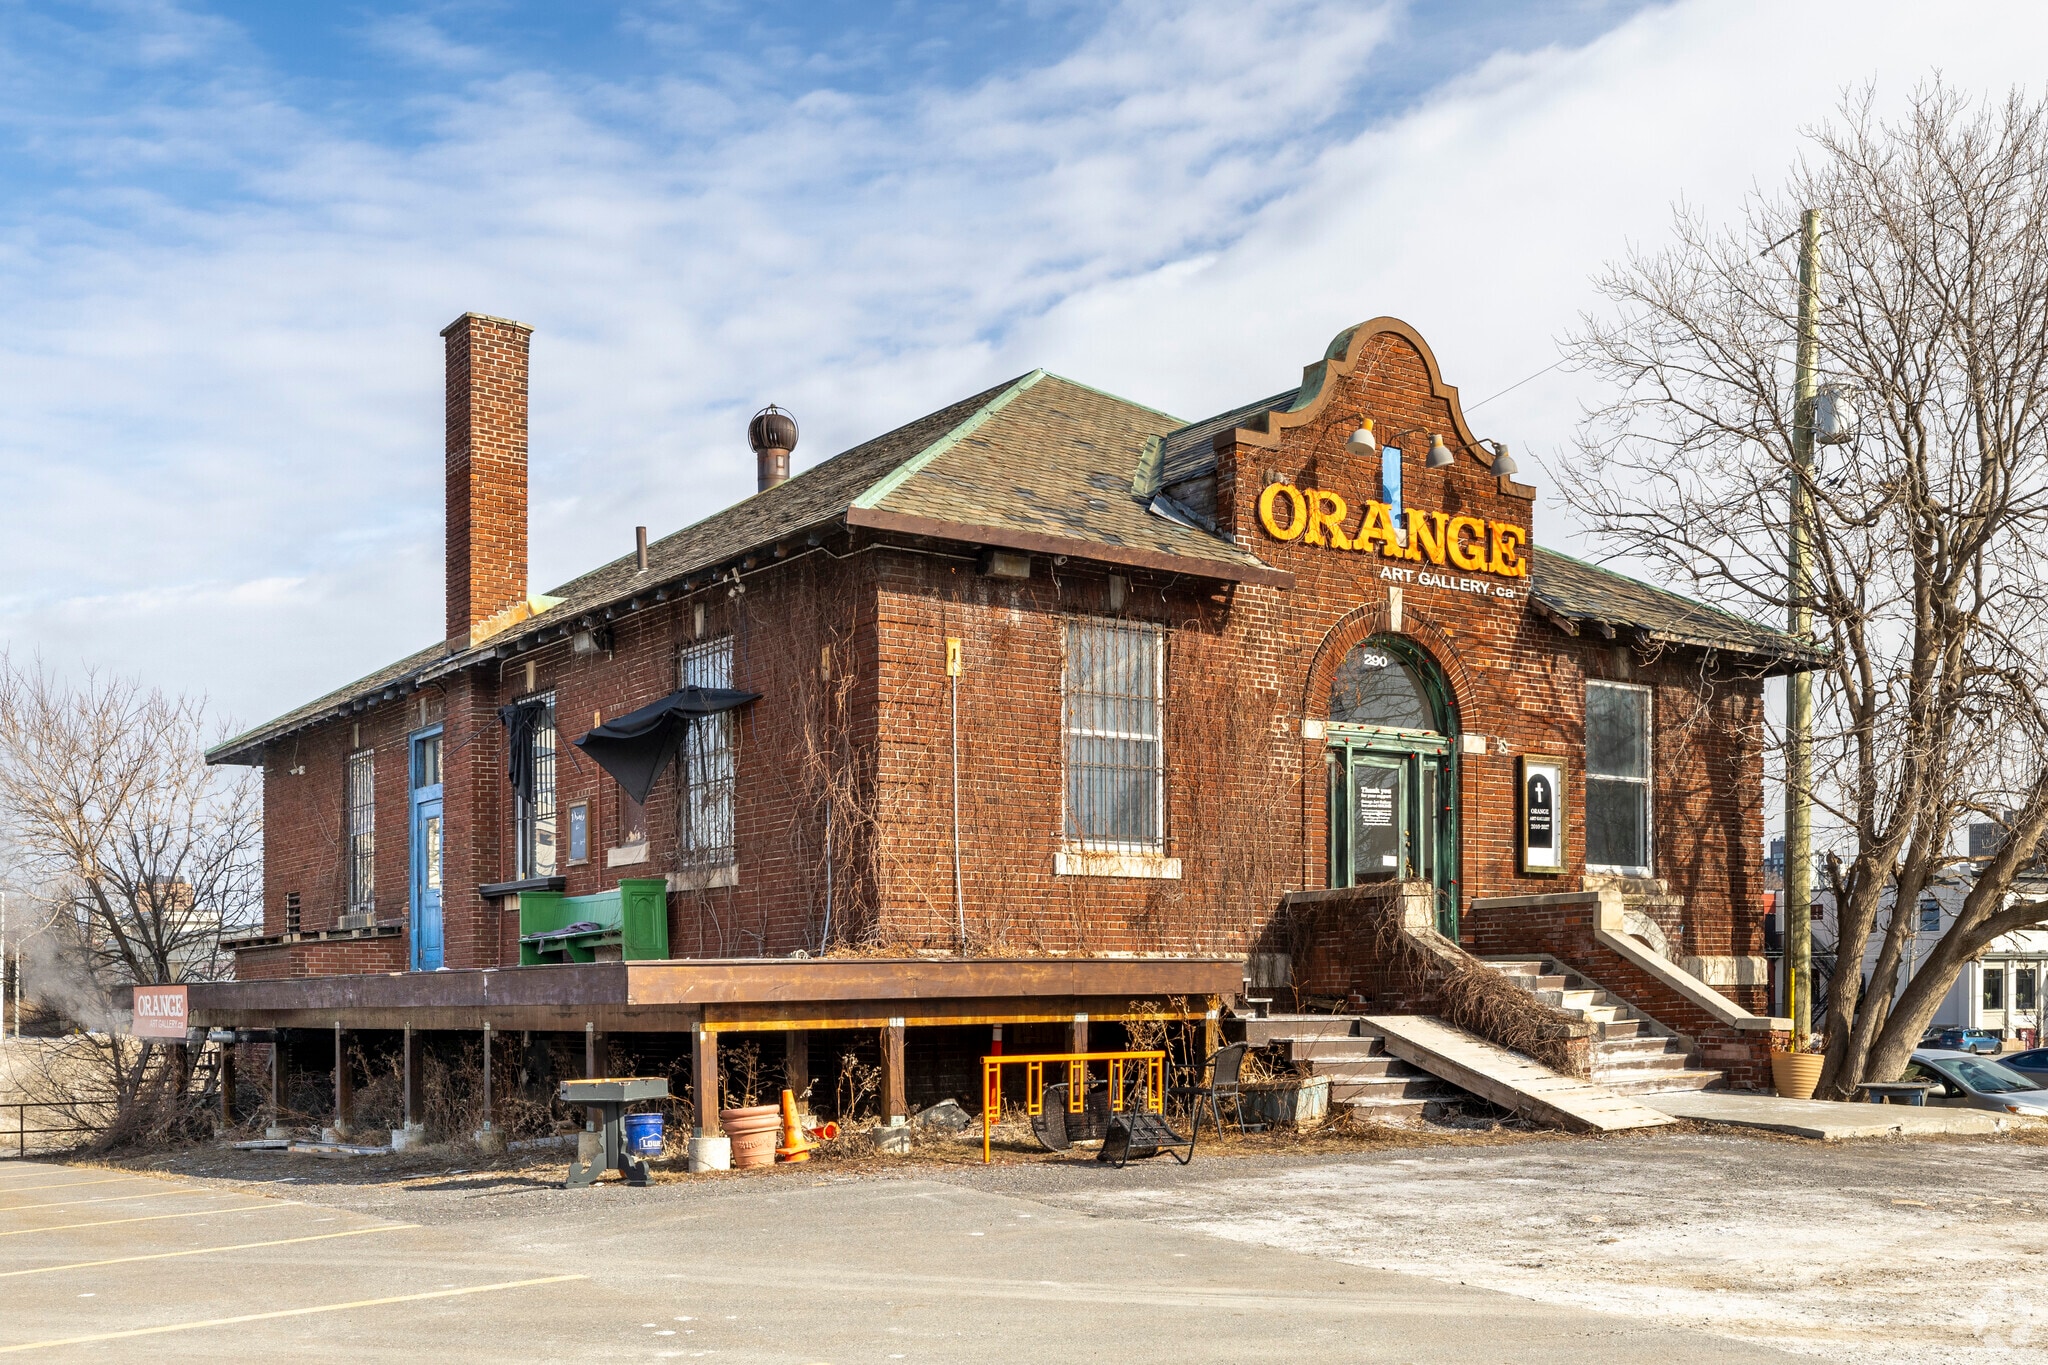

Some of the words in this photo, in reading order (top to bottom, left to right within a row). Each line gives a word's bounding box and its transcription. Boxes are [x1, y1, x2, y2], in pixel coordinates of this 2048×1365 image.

[1259, 482, 1527, 578] ORANGE
[1380, 566, 1413, 583] ART
[1364, 654, 1387, 667] 290
[138, 994, 184, 1017] ORANGE
